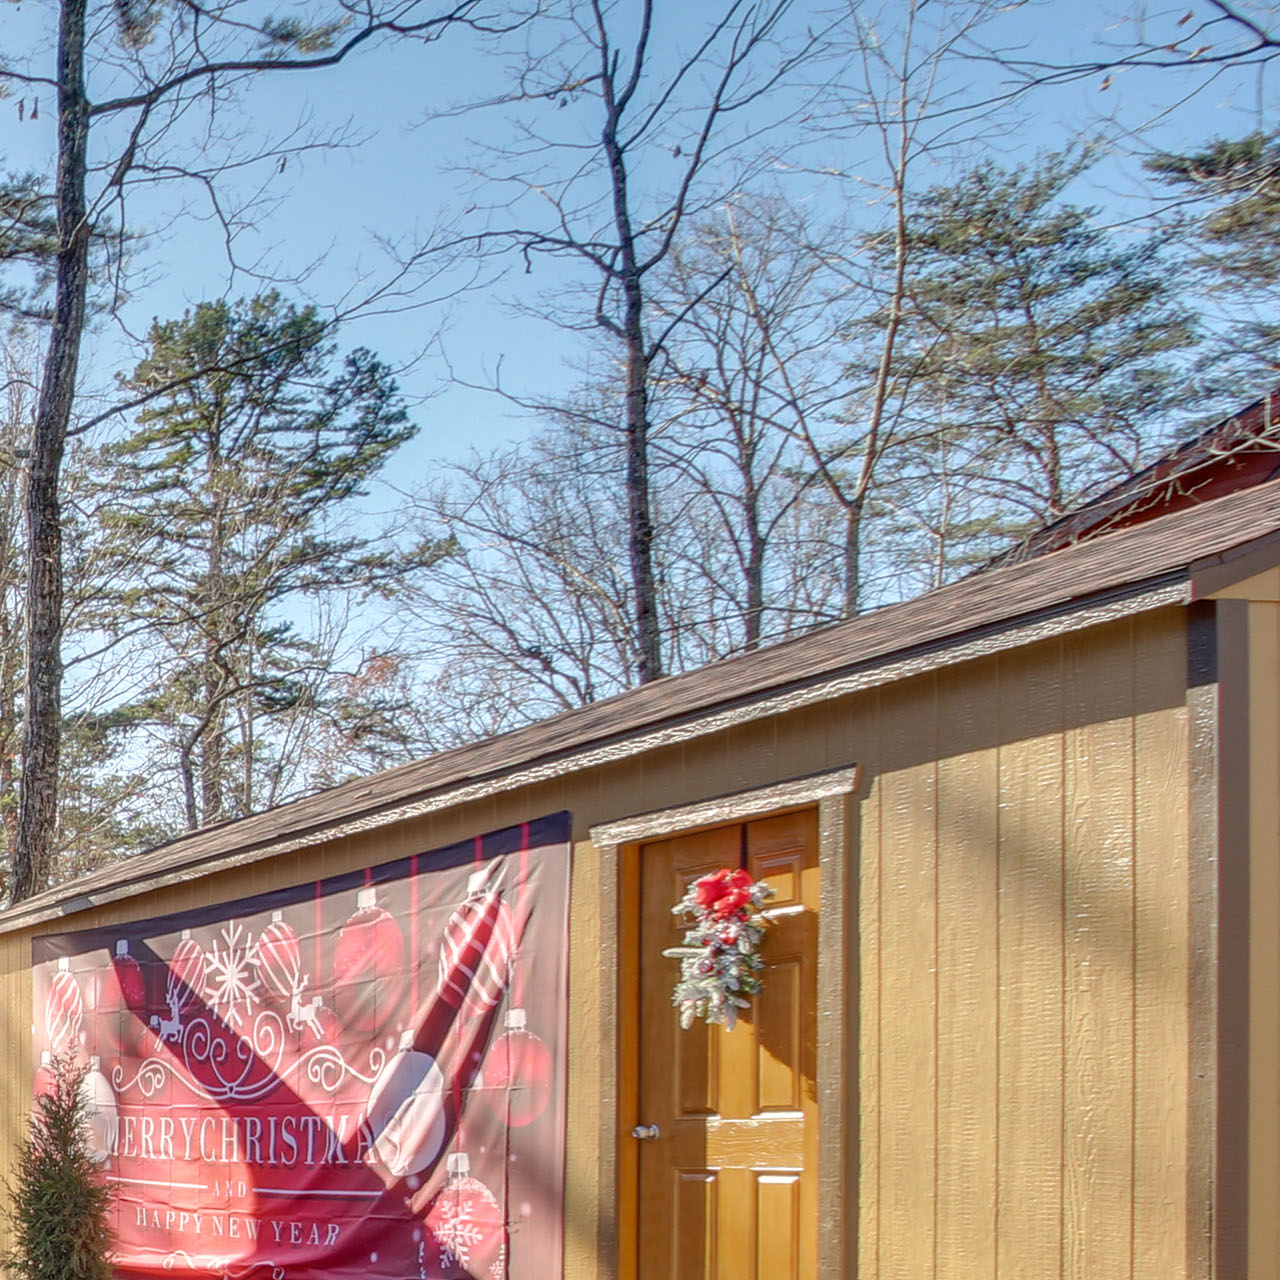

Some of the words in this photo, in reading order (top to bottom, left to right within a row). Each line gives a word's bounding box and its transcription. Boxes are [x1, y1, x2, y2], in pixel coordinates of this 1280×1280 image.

[212, 1180, 247, 1197] AND
[136, 1207, 202, 1234] HAPPY
[212, 1215, 262, 1241] NEW
[272, 1222, 340, 1247] YEAR
